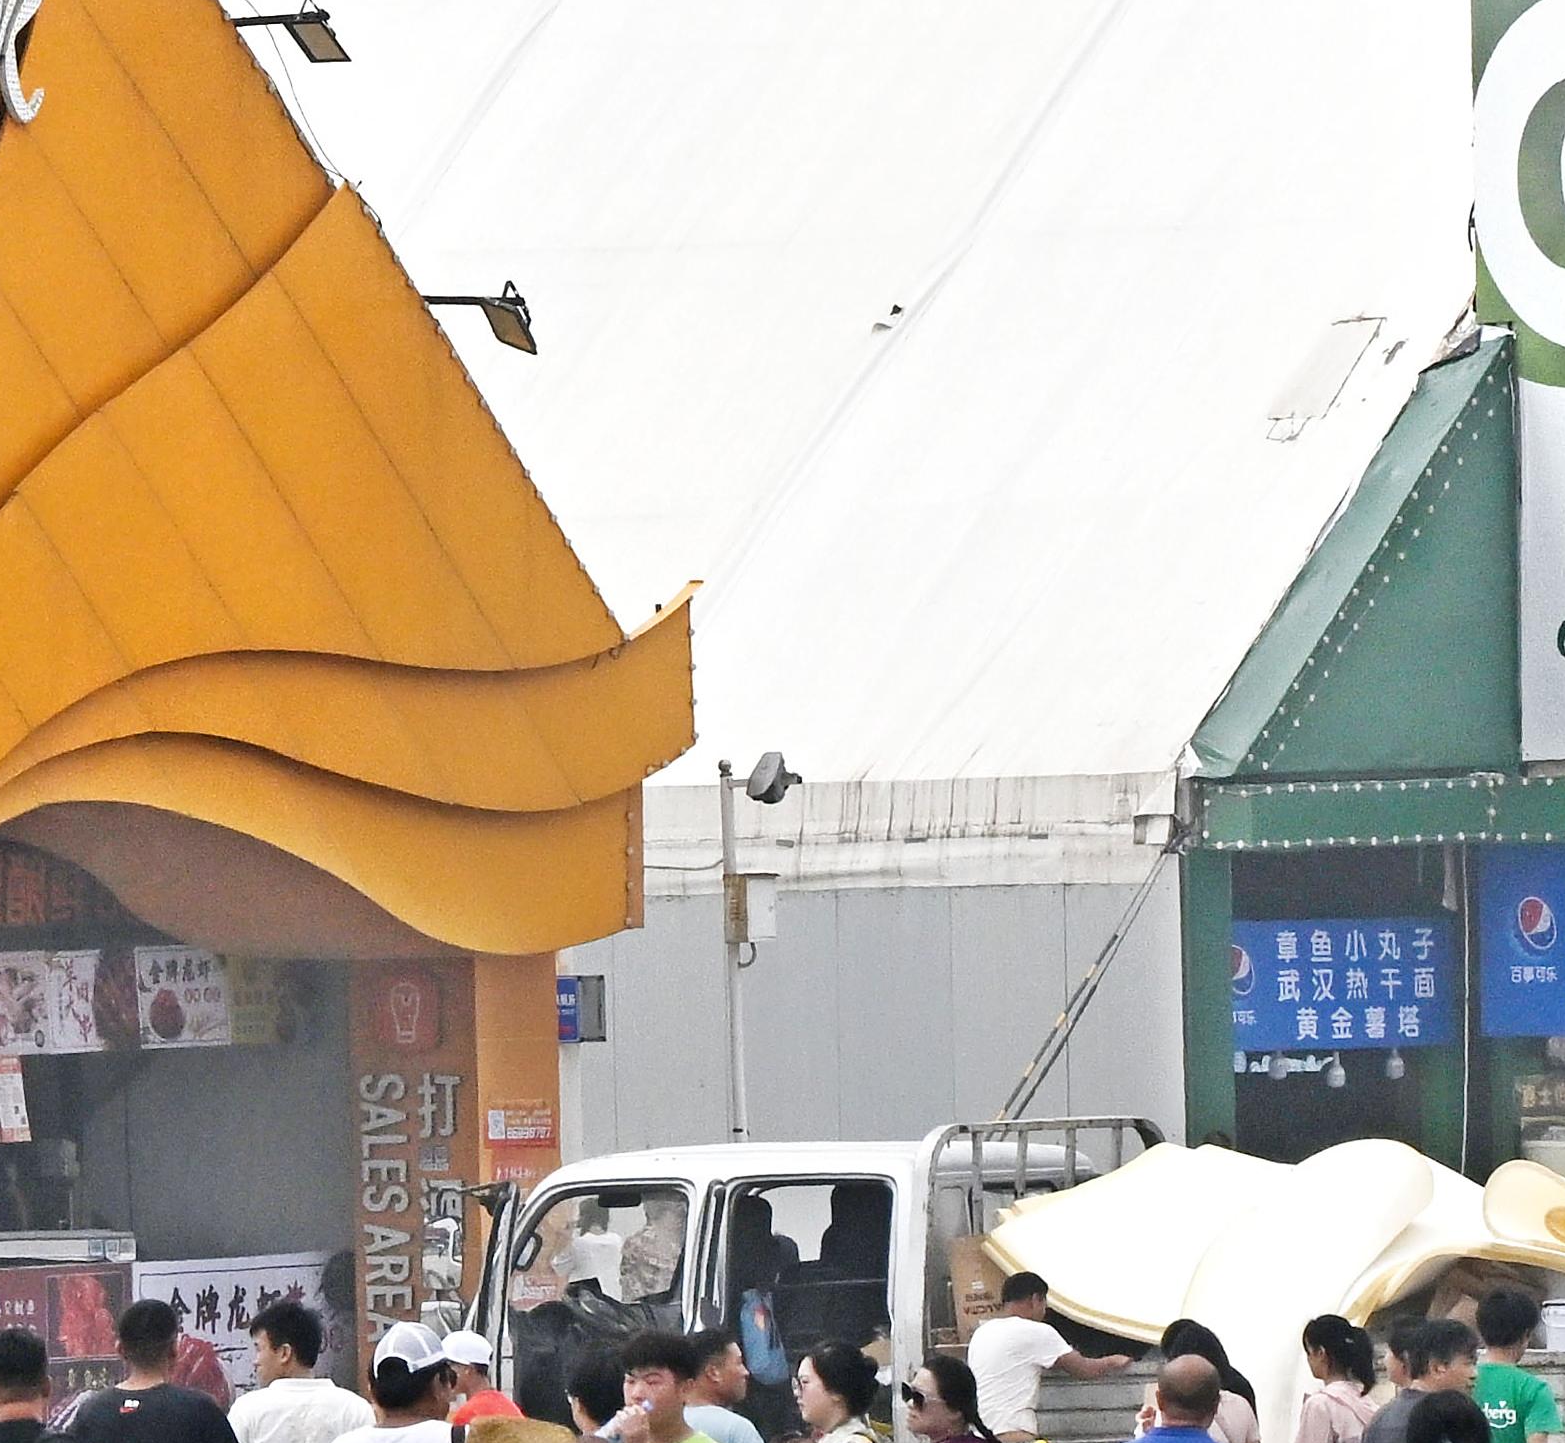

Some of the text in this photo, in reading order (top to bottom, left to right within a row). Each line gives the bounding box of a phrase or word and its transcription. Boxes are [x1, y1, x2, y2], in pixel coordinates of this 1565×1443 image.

[1276, 928, 1435, 963] 章鱼小丸子
[1277, 967, 1436, 1002] 武汉热干面
[1510, 965, 1559, 983] 百事可乐
[1296, 1006, 1421, 1041] 黄金薯塔
[359, 1074, 415, 1344] SALES AREA
